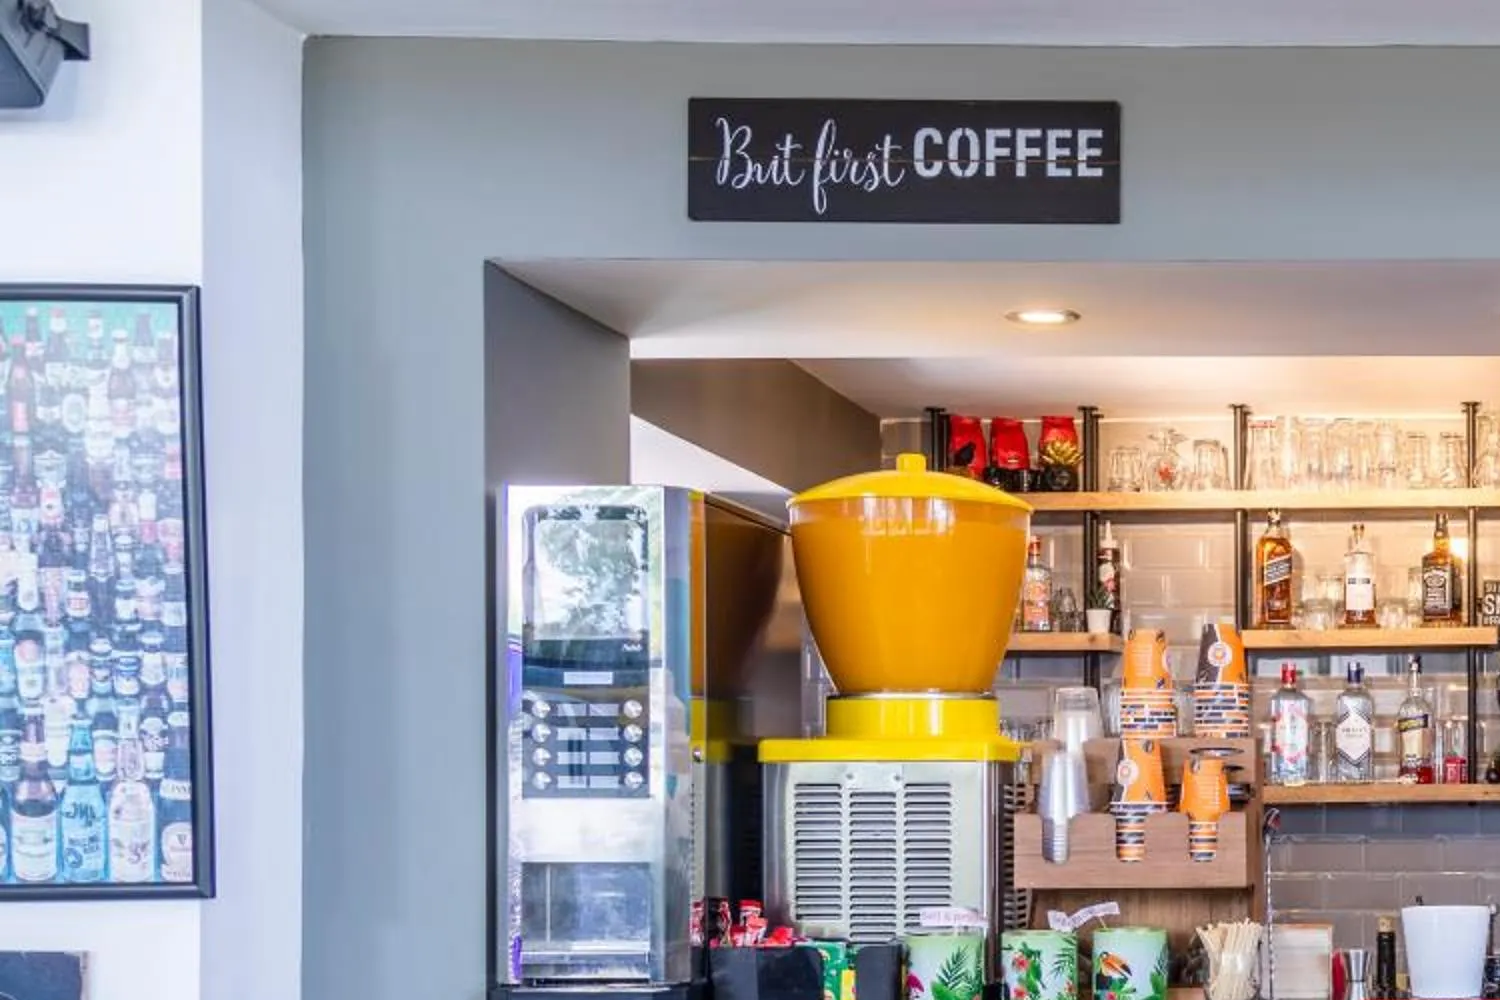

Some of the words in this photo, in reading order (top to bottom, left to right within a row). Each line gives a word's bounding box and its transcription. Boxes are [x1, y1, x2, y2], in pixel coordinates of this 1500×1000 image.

[715, 117, 806, 190] But
[811, 119, 905, 215] first
[913, 127, 1104, 178] COFFEE
